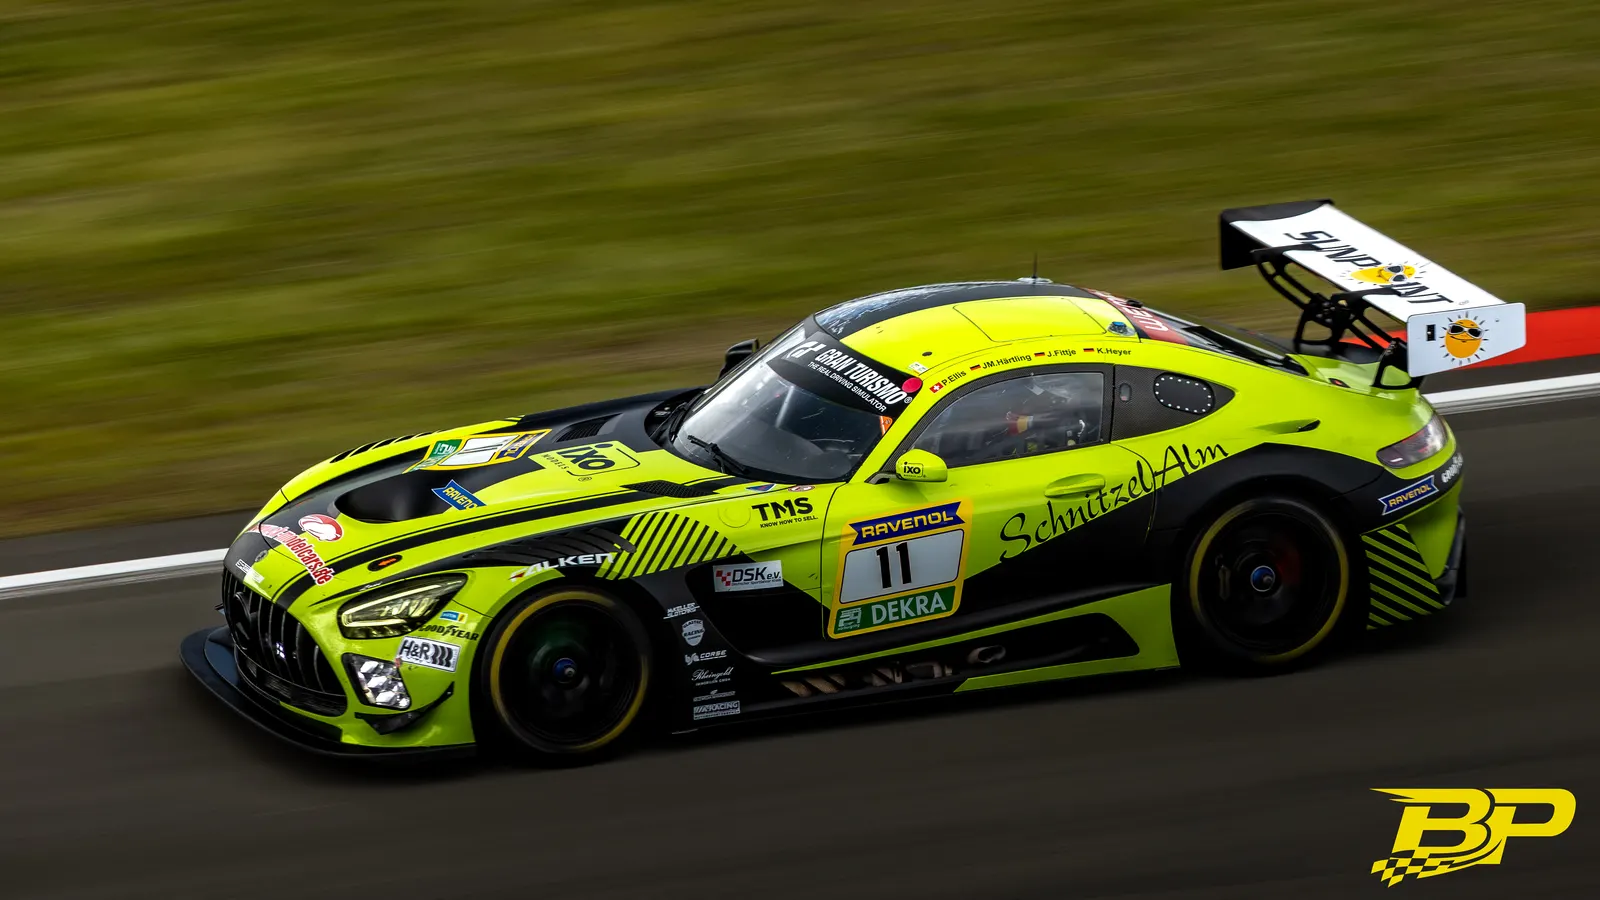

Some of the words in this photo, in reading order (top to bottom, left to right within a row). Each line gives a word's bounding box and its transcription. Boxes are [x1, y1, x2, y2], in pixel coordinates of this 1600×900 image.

[982, 354, 1032, 370] JM.Härtling
[1047, 348, 1077, 358] J.Fittje
[1097, 347, 1131, 356] K.Heyer
[807, 361, 820, 370] THE
[817, 366, 832, 377] REAL
[829, 372, 854, 389] DRIVING
[851, 385, 887, 412] SIMULATOR
[815, 348, 857, 372] GRAN
[843, 363, 908, 405] TURISMO
[941, 370, 967, 386] P.Ellis
[442, 486, 478, 511] RAVENO
[1388, 484, 1432, 508] RAVENOL
[751, 497, 814, 521] TMS
[860, 510, 954, 539] RAVENOL
[508, 552, 614, 582] FALKEN
[731, 566, 767, 583] DSK
[876, 542, 912, 589] 11
[871, 591, 947, 625] DEKRA
[418, 624, 480, 641] GOODYEAR
[400, 639, 430, 660] H&R
